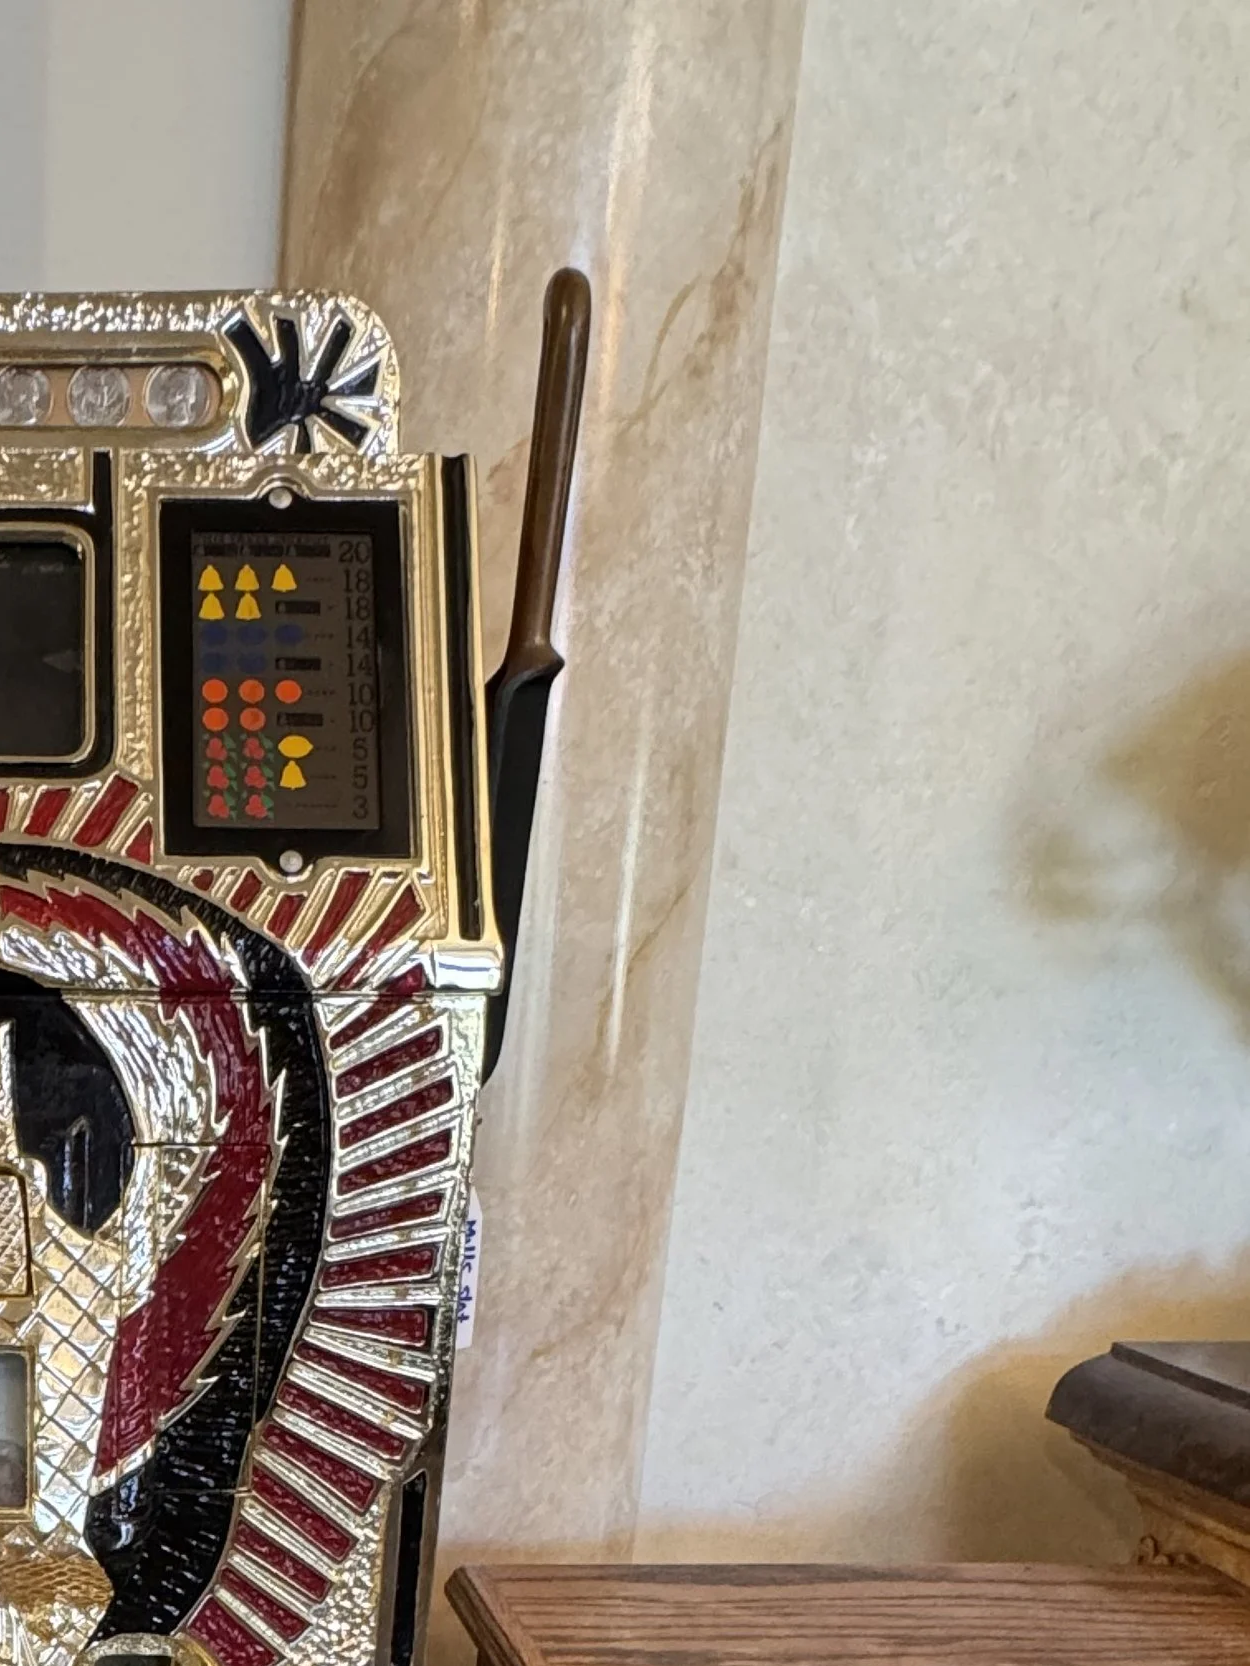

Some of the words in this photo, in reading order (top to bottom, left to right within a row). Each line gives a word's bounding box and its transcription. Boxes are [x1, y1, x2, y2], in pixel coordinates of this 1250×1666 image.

[338, 540, 370, 564] 20
[343, 568, 370, 593] 18
[345, 596, 370, 621] 18
[347, 625, 370, 649] 14
[347, 652, 372, 677] 14
[348, 682, 375, 706] 10
[349, 709, 375, 733] 10
[353, 764, 368, 789] 5
[352, 795, 368, 819] 3
